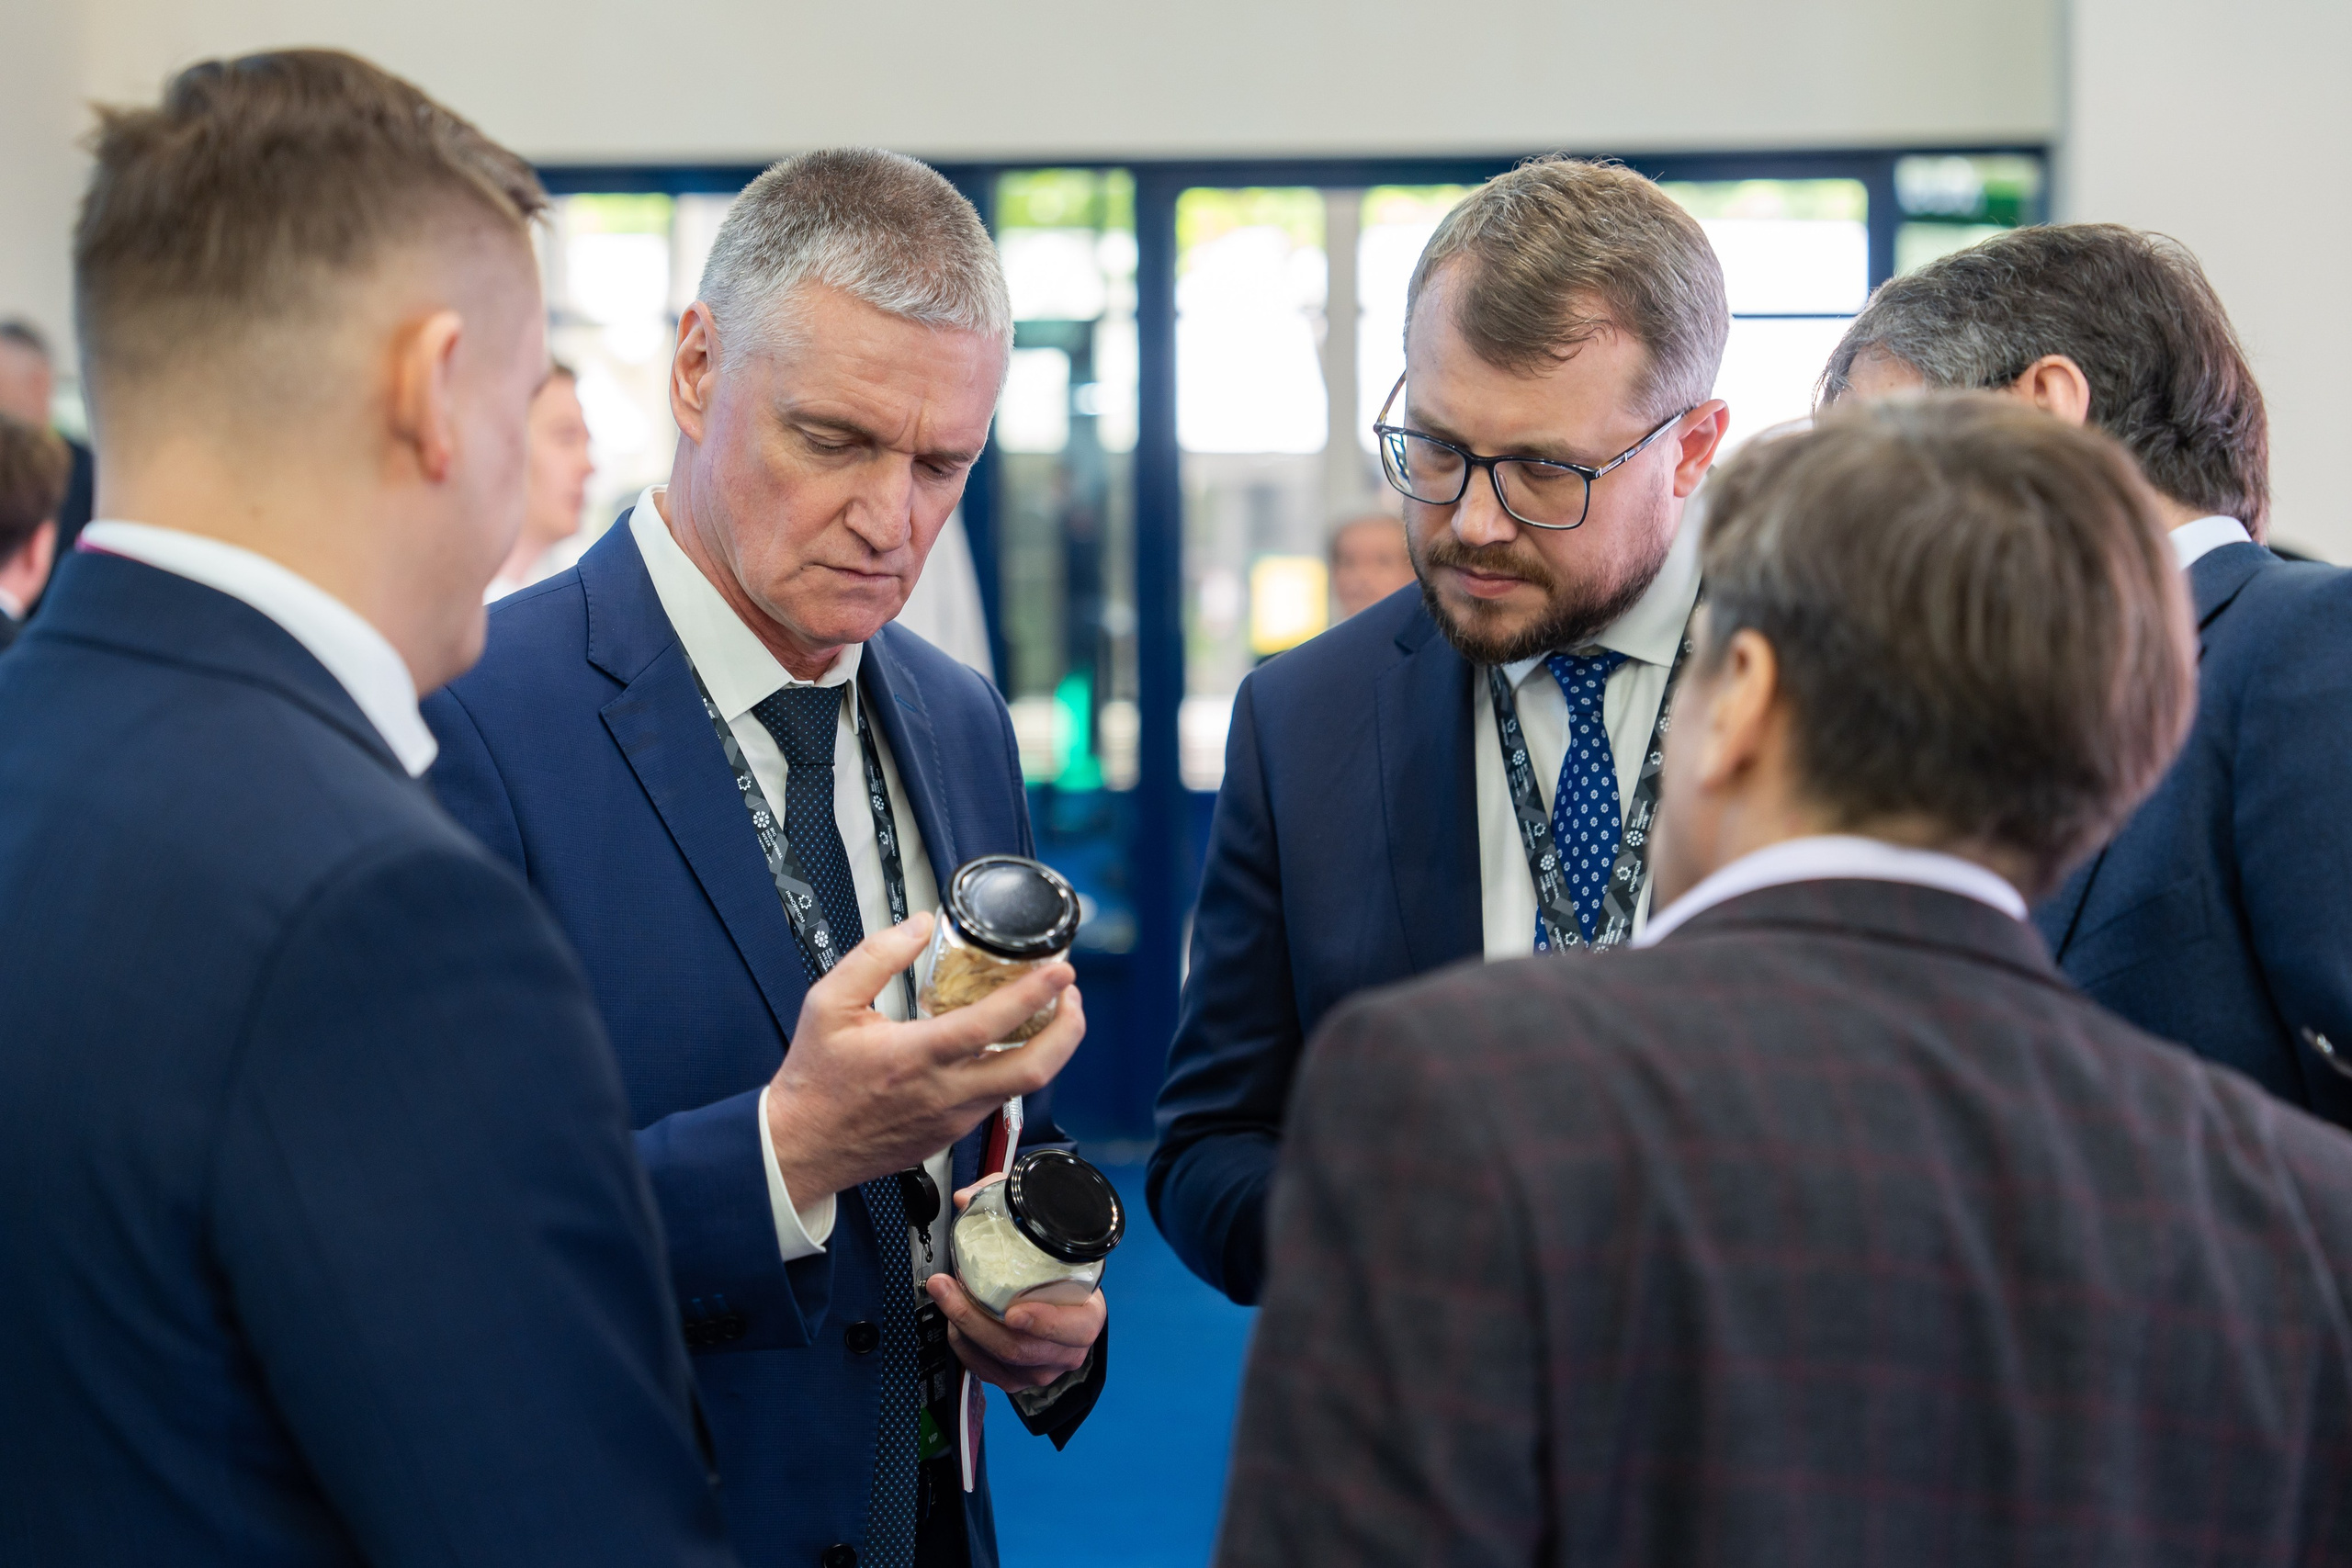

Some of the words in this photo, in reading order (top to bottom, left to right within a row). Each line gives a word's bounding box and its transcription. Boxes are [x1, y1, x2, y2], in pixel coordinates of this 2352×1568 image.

[761, 831, 772, 847] WEEK
[765, 829, 783, 860] INDUSTRIAL
[1628, 860, 1642, 892] INNOPROM
[785, 890, 805, 923] INNOPROM
[822, 951, 830, 967] WEEK
[928, 1432, 938, 1444] VIP
